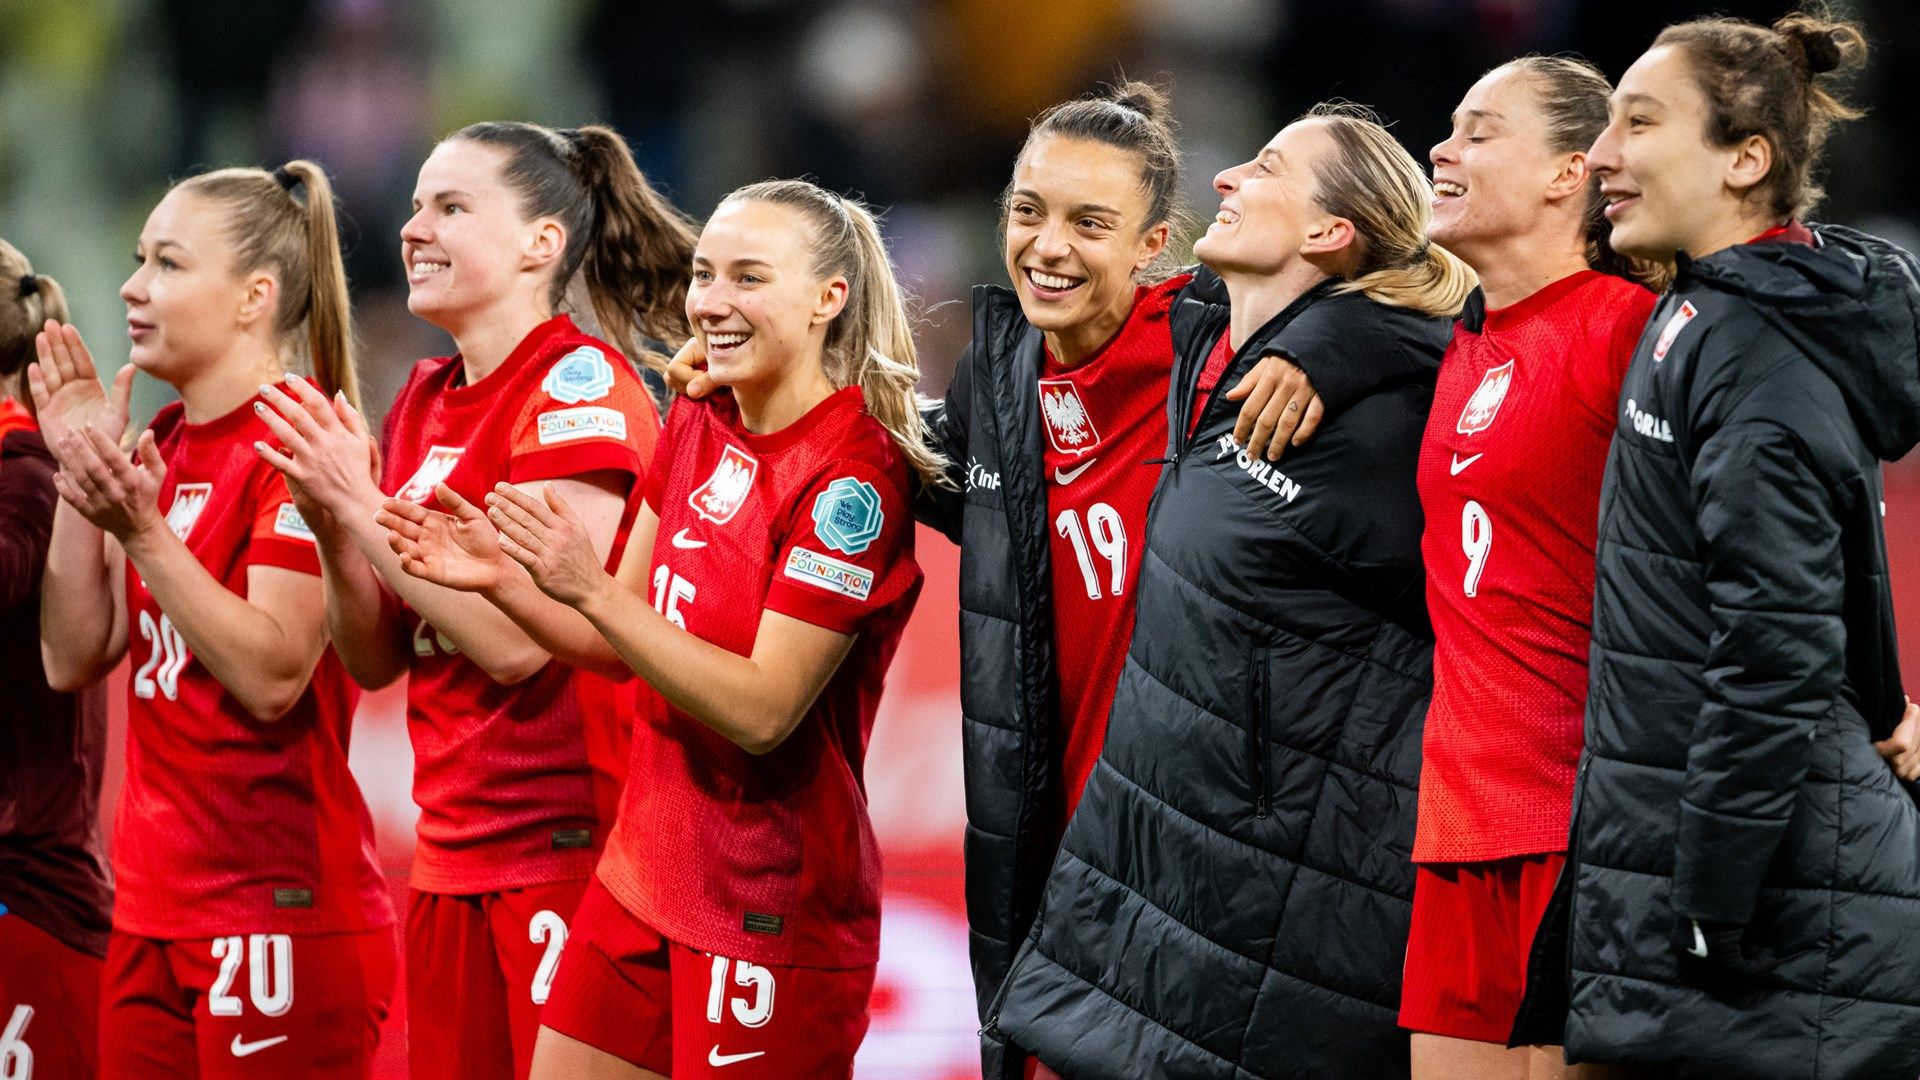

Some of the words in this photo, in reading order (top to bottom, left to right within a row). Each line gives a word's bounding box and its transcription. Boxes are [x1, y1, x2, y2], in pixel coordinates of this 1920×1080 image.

[1236, 448, 1302, 503] ORLEN
[834, 515, 862, 533] Strong
[1055, 502, 1128, 600] 19
[1461, 499, 1493, 598] 9
[134, 608, 188, 702] 20
[208, 933, 295, 1018] 20
[705, 952, 776, 1029] 15
